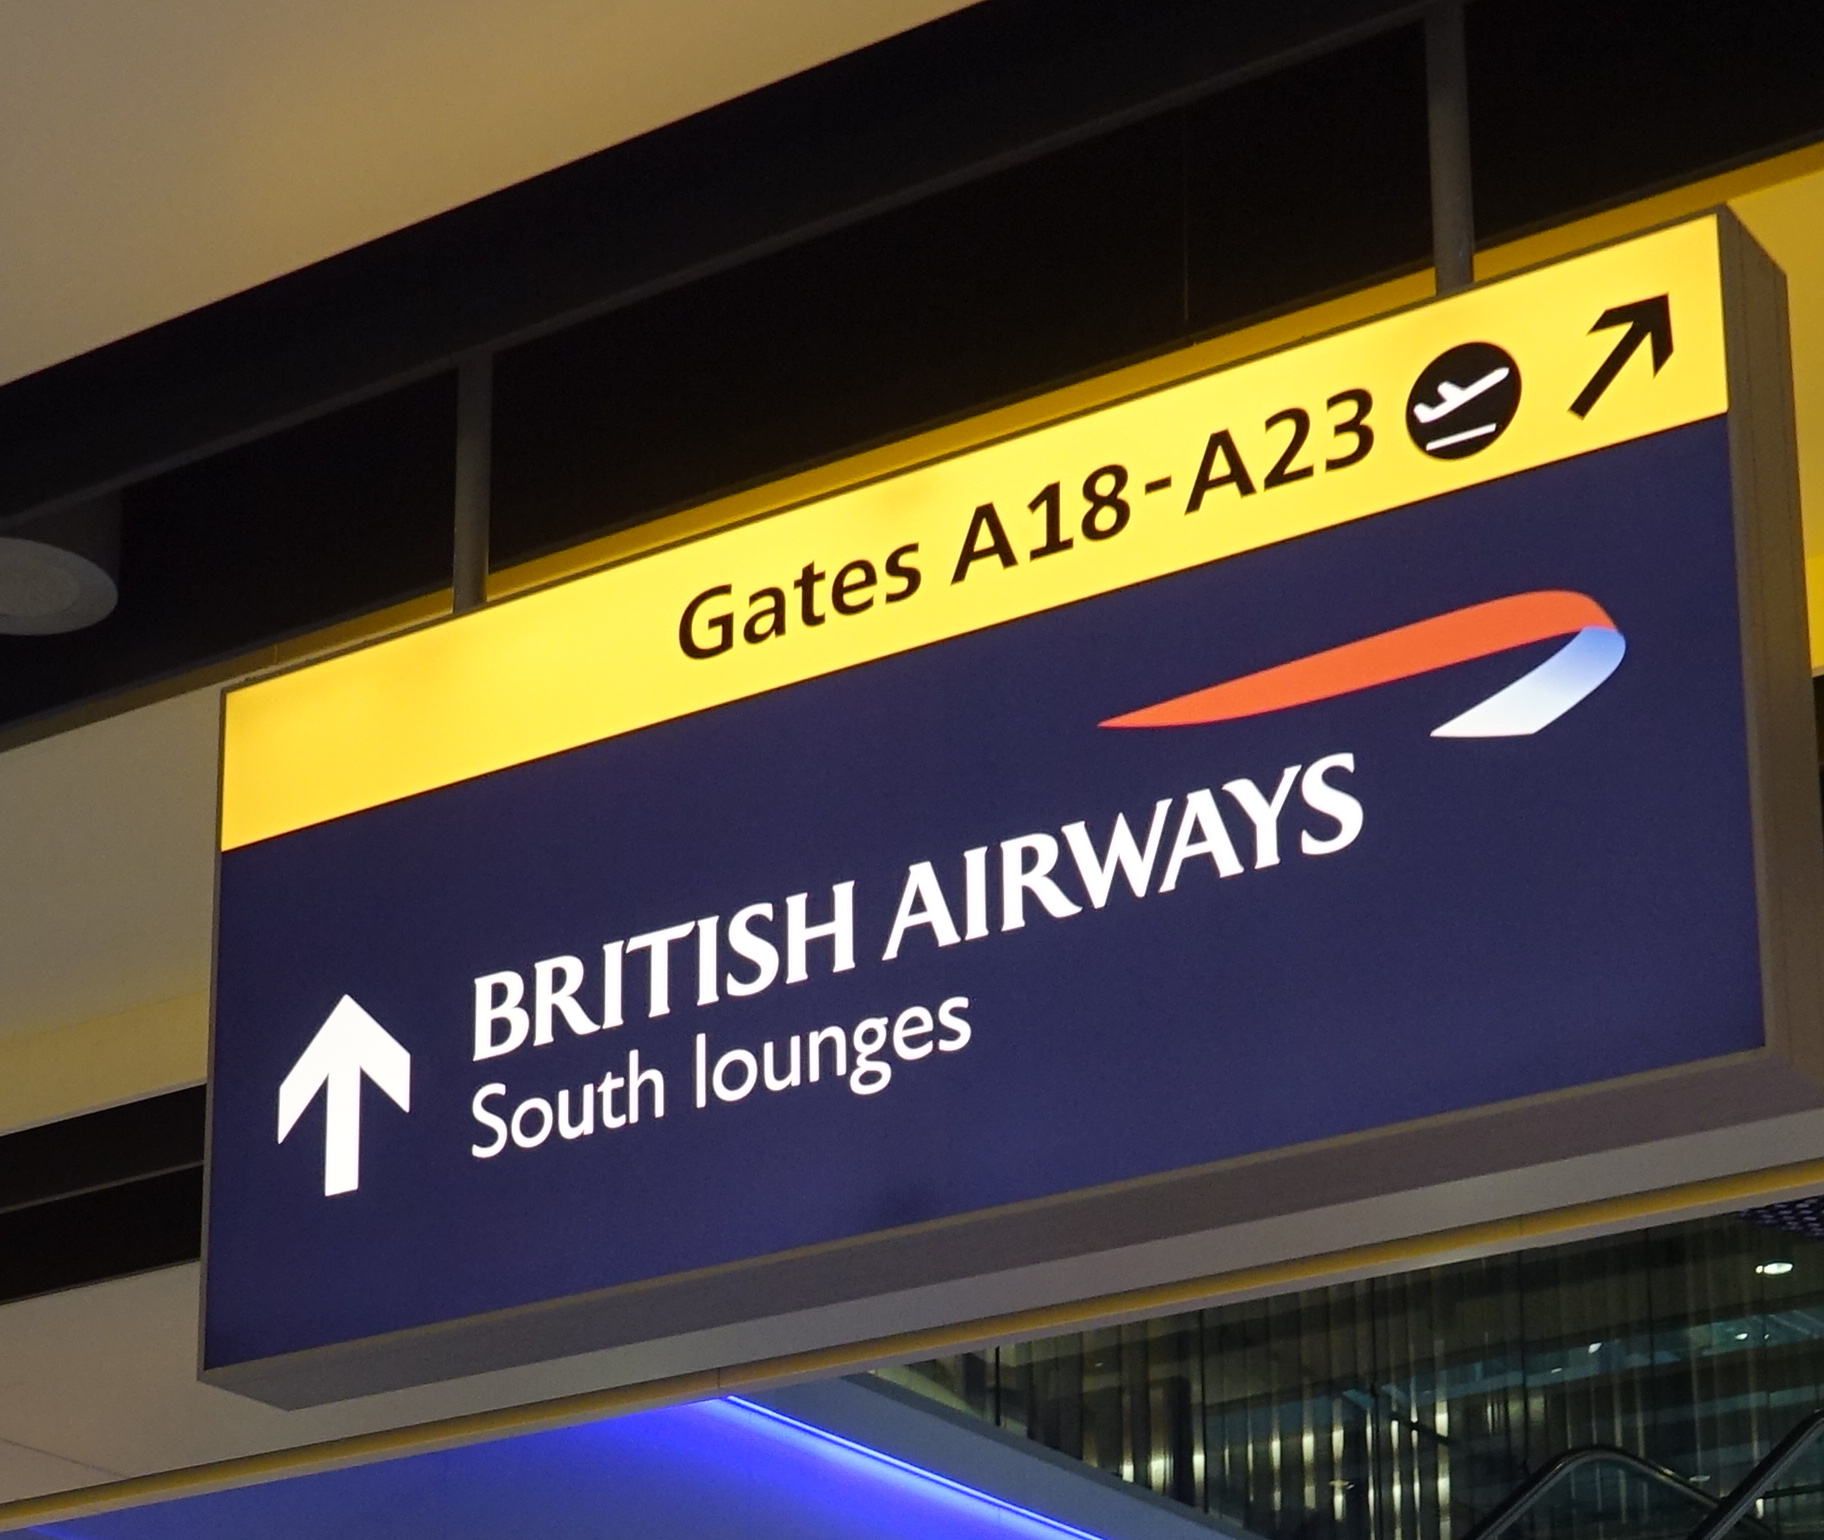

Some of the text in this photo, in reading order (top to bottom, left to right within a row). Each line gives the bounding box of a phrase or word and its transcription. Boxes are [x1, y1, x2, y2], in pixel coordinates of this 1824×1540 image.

[678, 387, 1375, 660] Gates A18-A23
[472, 752, 1365, 1062] BRITISH AIRWAYS
[470, 995, 972, 1160] South lounges
